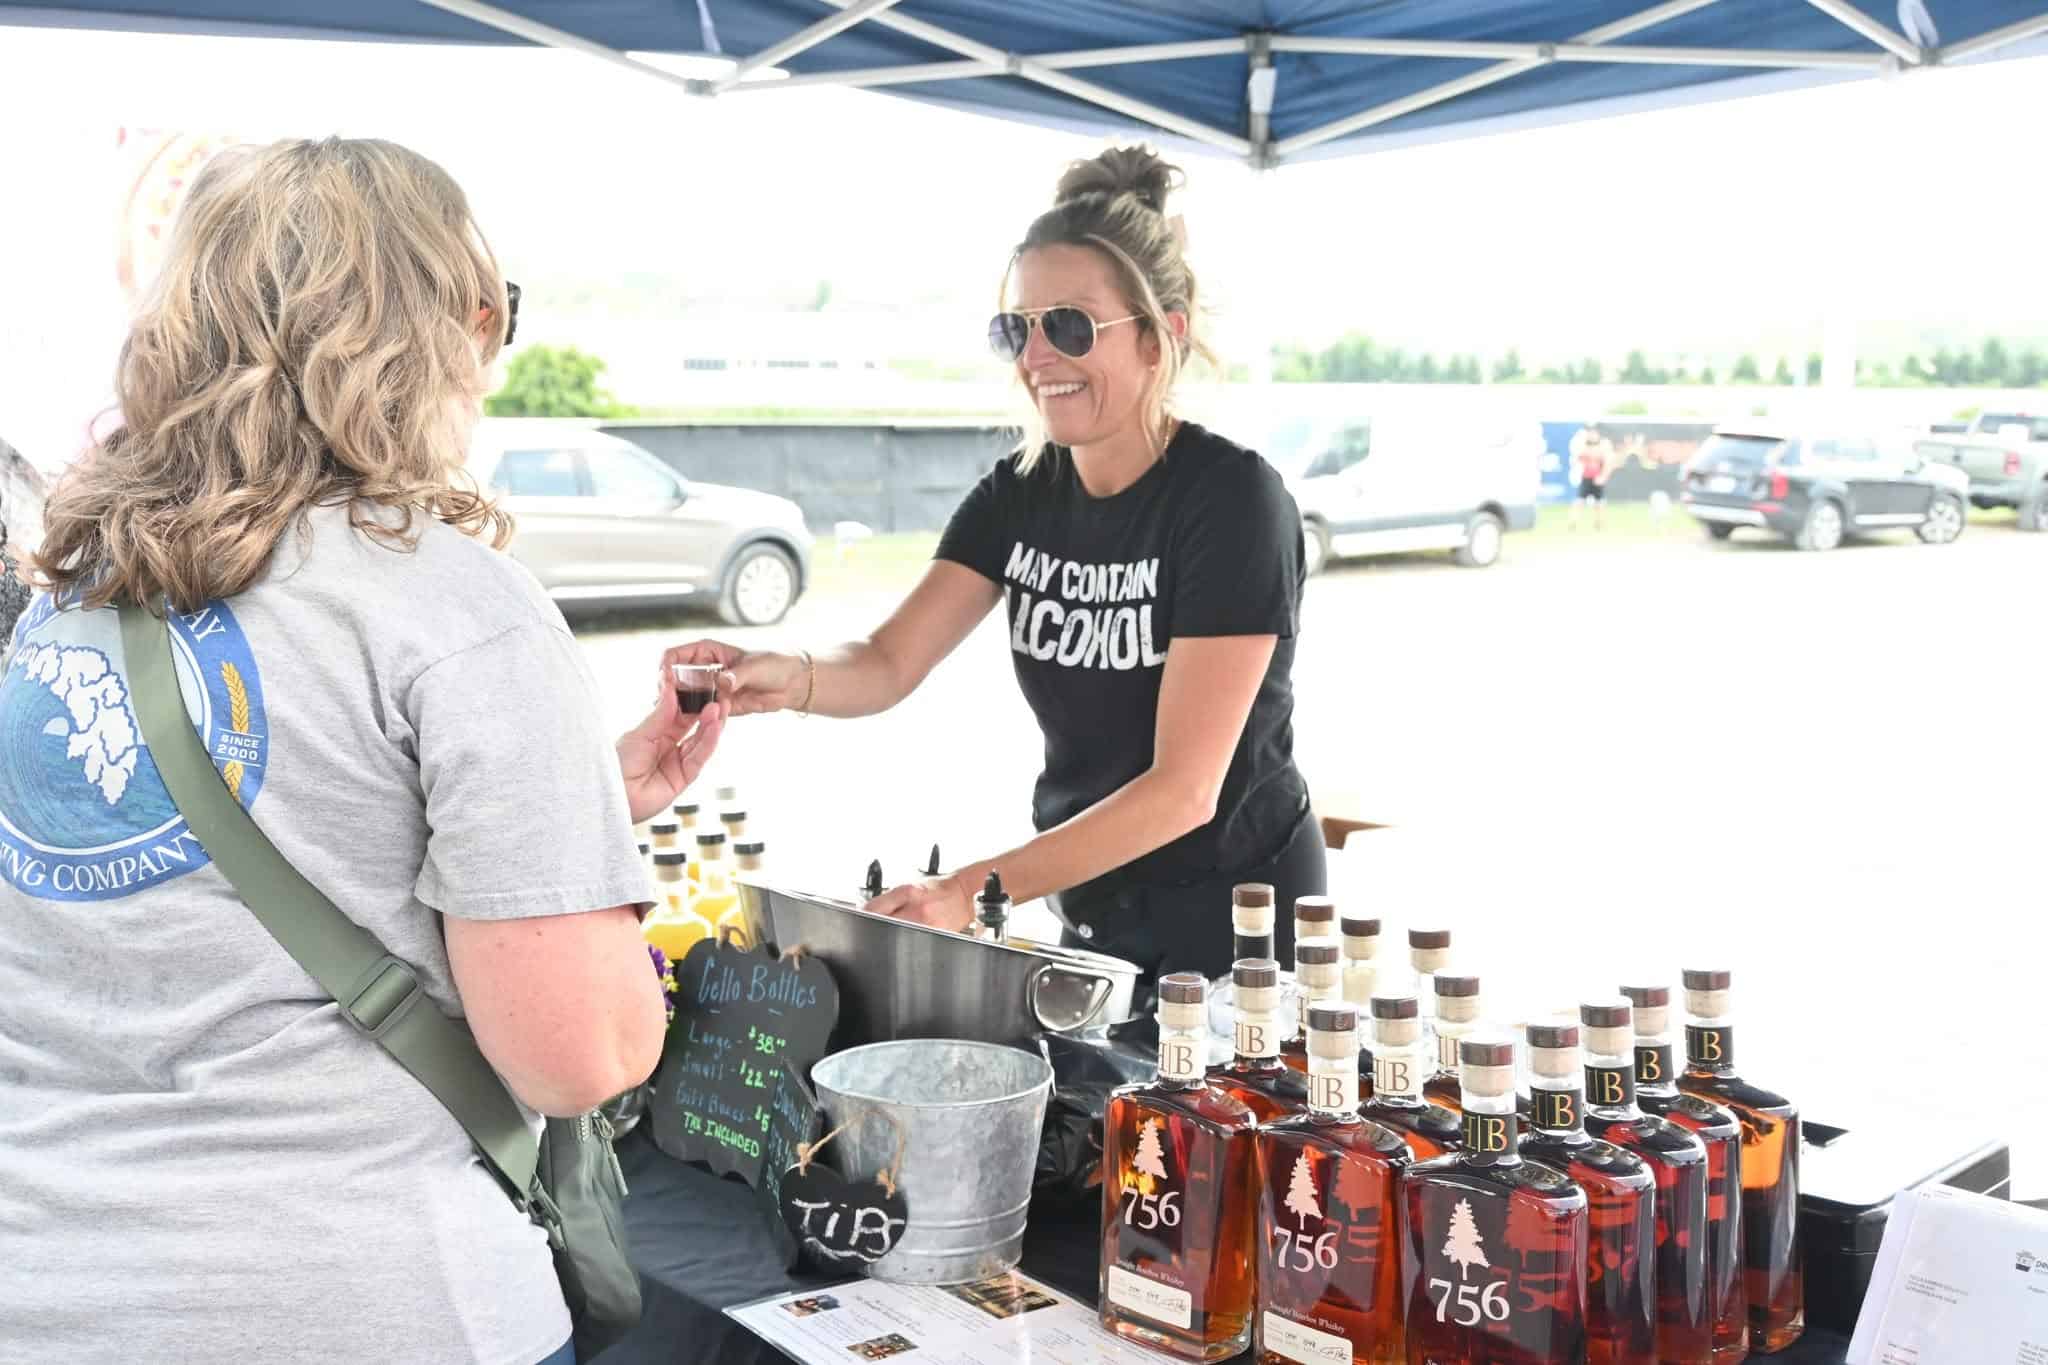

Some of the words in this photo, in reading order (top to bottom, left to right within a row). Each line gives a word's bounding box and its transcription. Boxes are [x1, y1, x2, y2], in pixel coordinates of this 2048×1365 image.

[1004, 542, 1061, 593] MAY
[1062, 558, 1159, 603] CONTAIN
[1005, 585, 1168, 670] LCOHOL
[217, 744, 258, 760] 2000
[221, 735, 259, 749] SINCE
[747, 964, 817, 1008] Bottles
[1121, 1186, 1180, 1229] 756
[1274, 1226, 1338, 1273] 756
[1430, 1278, 1510, 1326] 756
